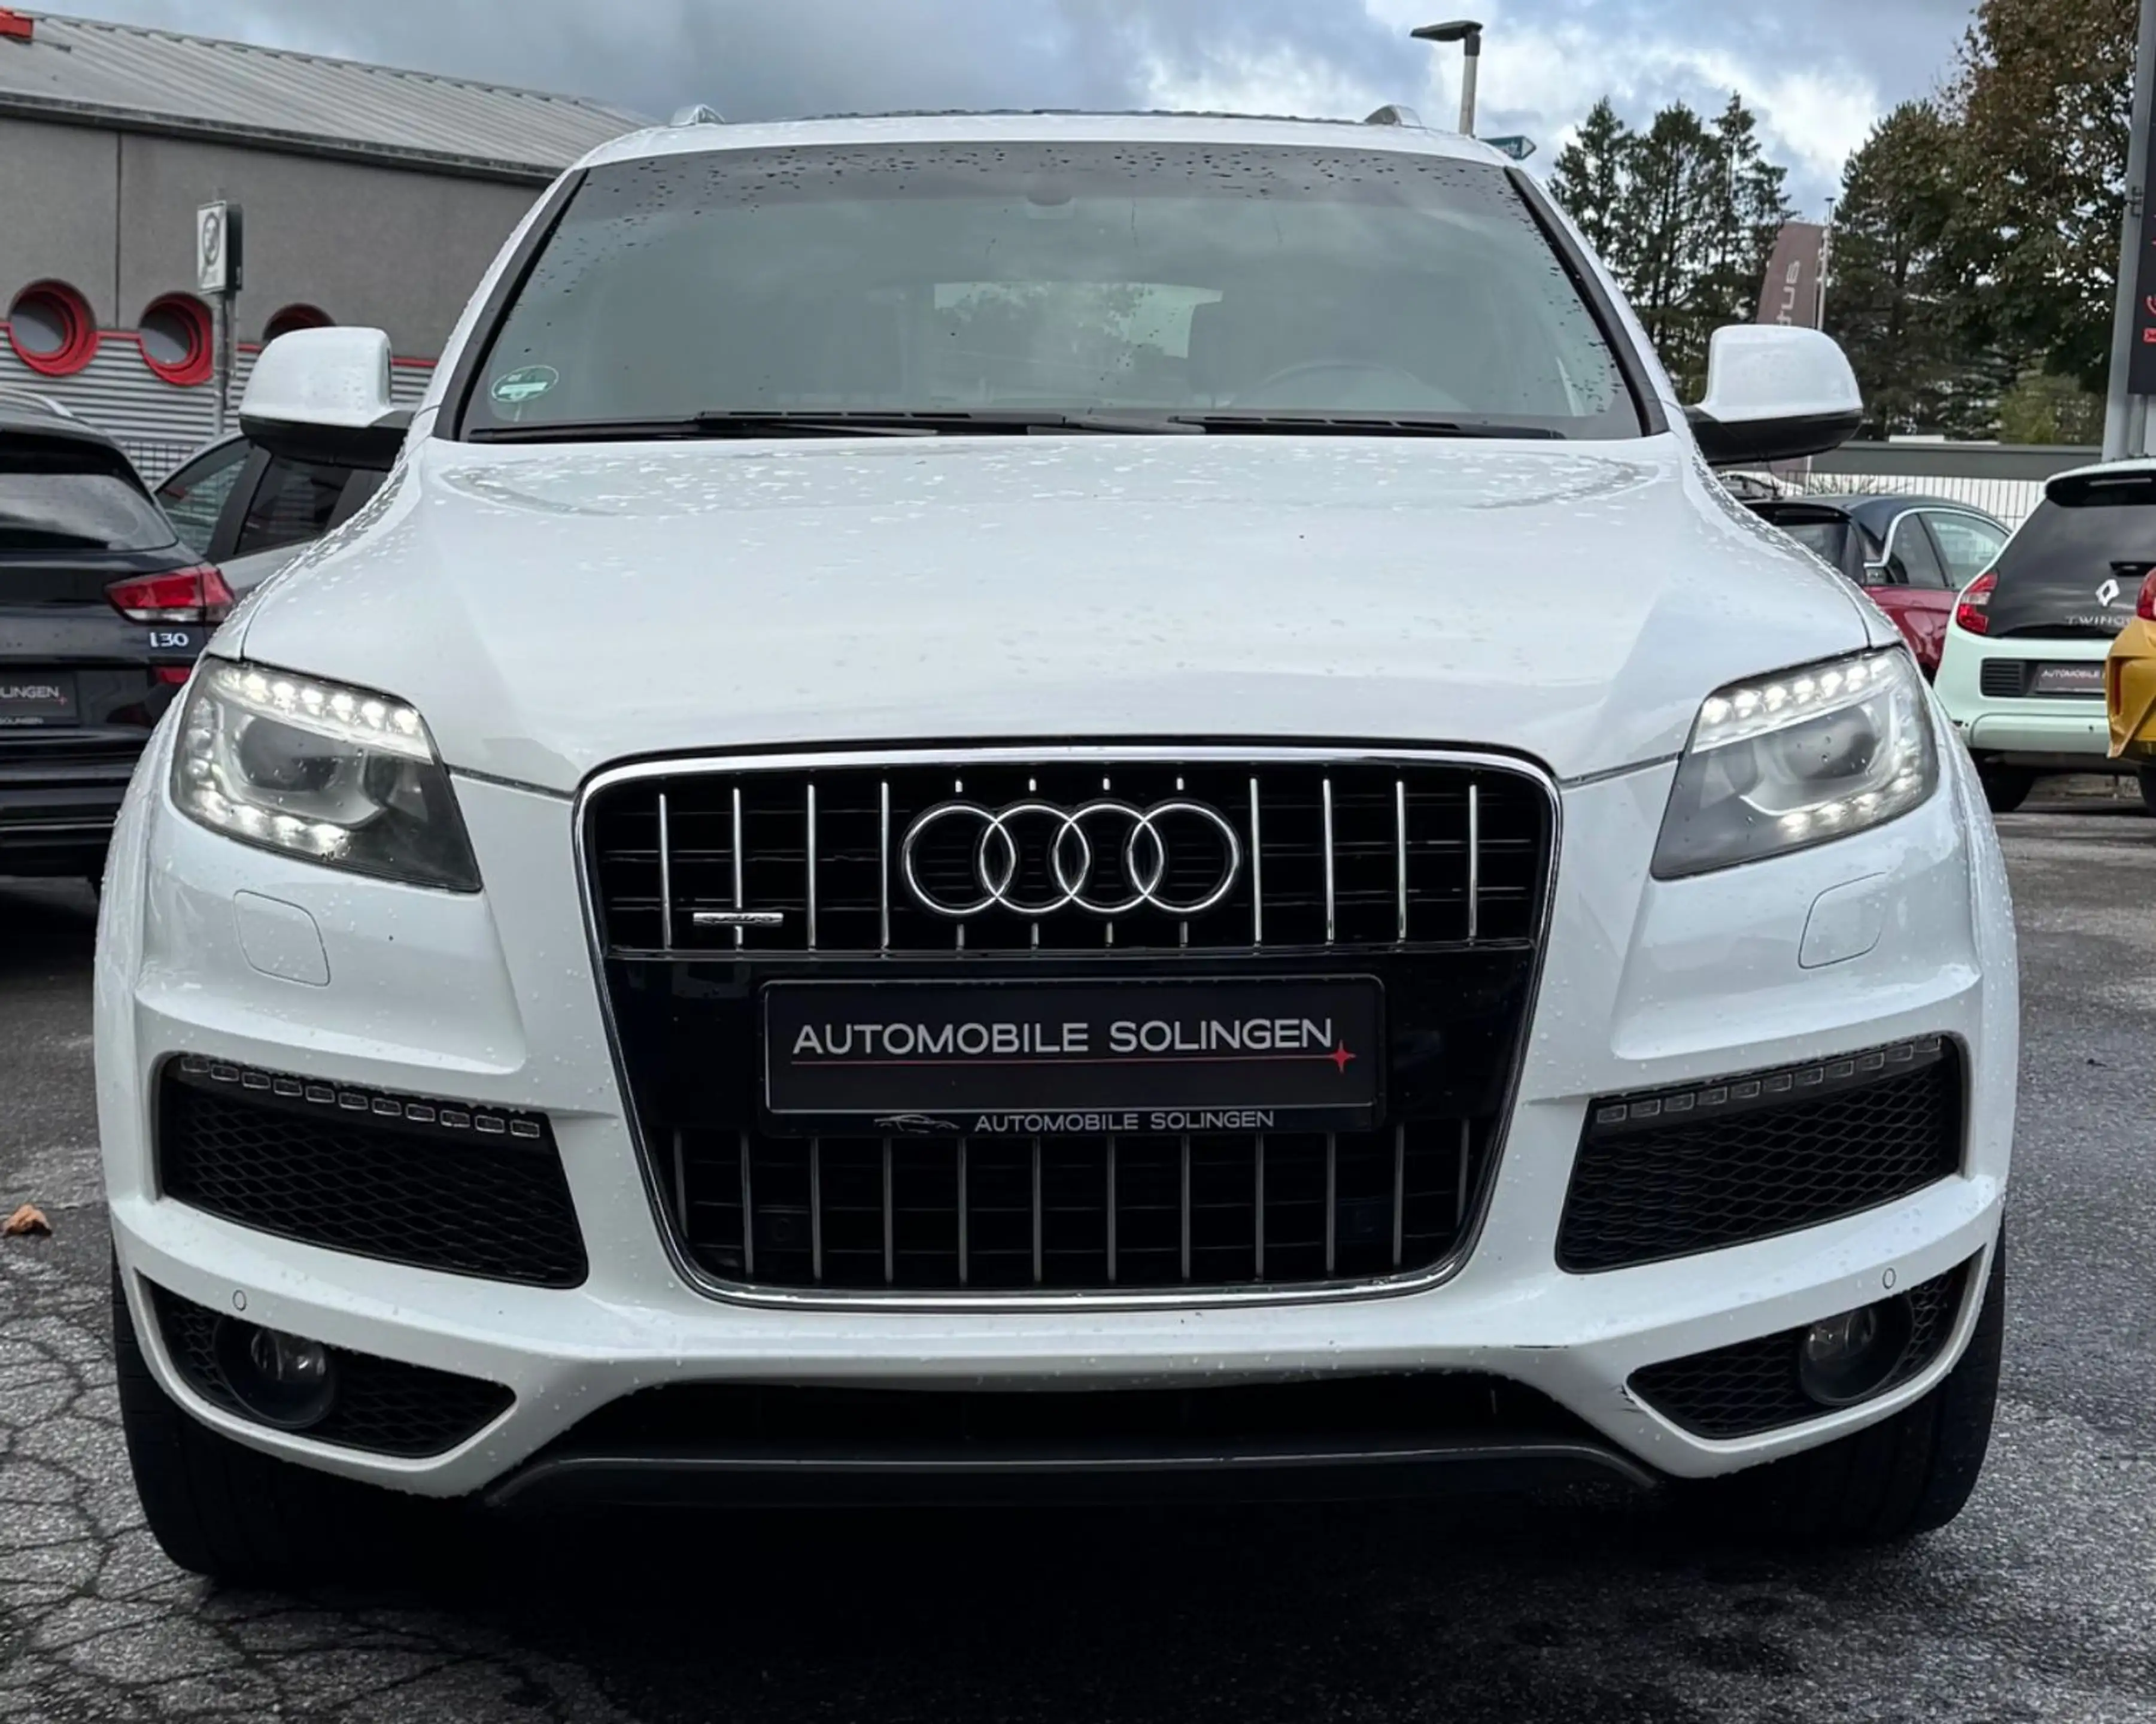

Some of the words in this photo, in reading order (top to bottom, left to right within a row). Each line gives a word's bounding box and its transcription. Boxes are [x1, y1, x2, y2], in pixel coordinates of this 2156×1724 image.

[2041, 669, 2100, 679] AUTOMOBILE
[0, 685, 59, 699] LINGEN
[792, 1022, 1089, 1055] AUTOMOBILE
[1109, 1018, 1332, 1052] SOLINGEN
[974, 1113, 1140, 1133] AUTOMOBILE
[1150, 1110, 1275, 1130] SOLINGEN
